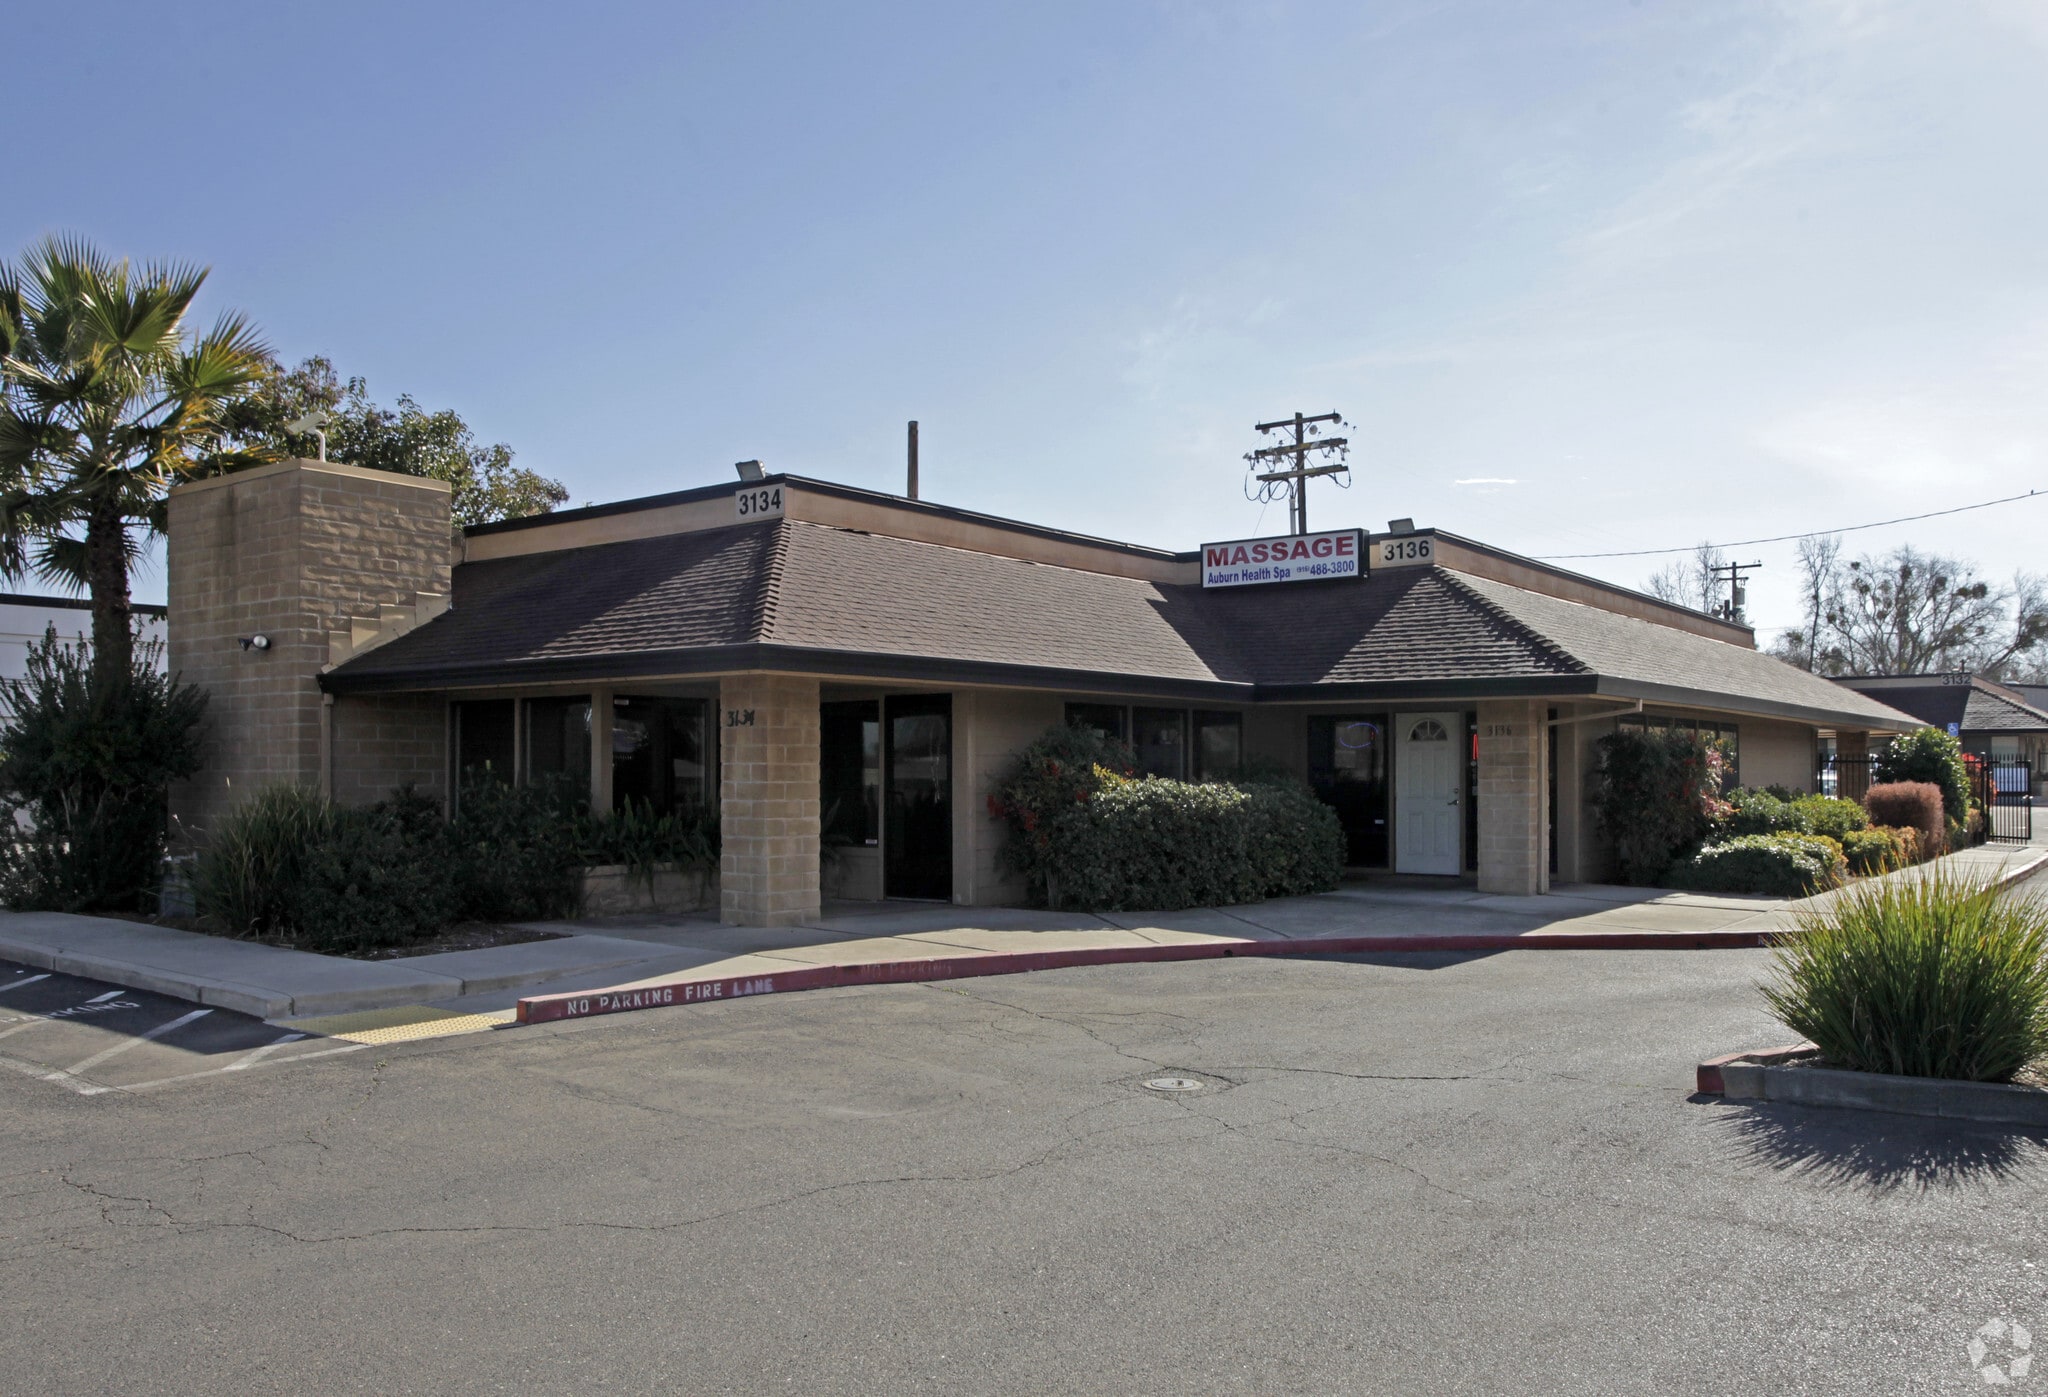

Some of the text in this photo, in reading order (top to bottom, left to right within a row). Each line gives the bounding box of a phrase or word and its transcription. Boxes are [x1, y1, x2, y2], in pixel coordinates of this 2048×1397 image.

[739, 488, 781, 515] 3134
[1207, 536, 1354, 567] MASSAGE
[1384, 540, 1430, 561] 3136
[1208, 571, 1239, 584] Auburn
[1242, 567, 1271, 581] Health
[1273, 566, 1291, 582] Spa
[1942, 674, 1971, 685] 3132
[567, 978, 774, 1015] NO PARKING FIRE LANE
